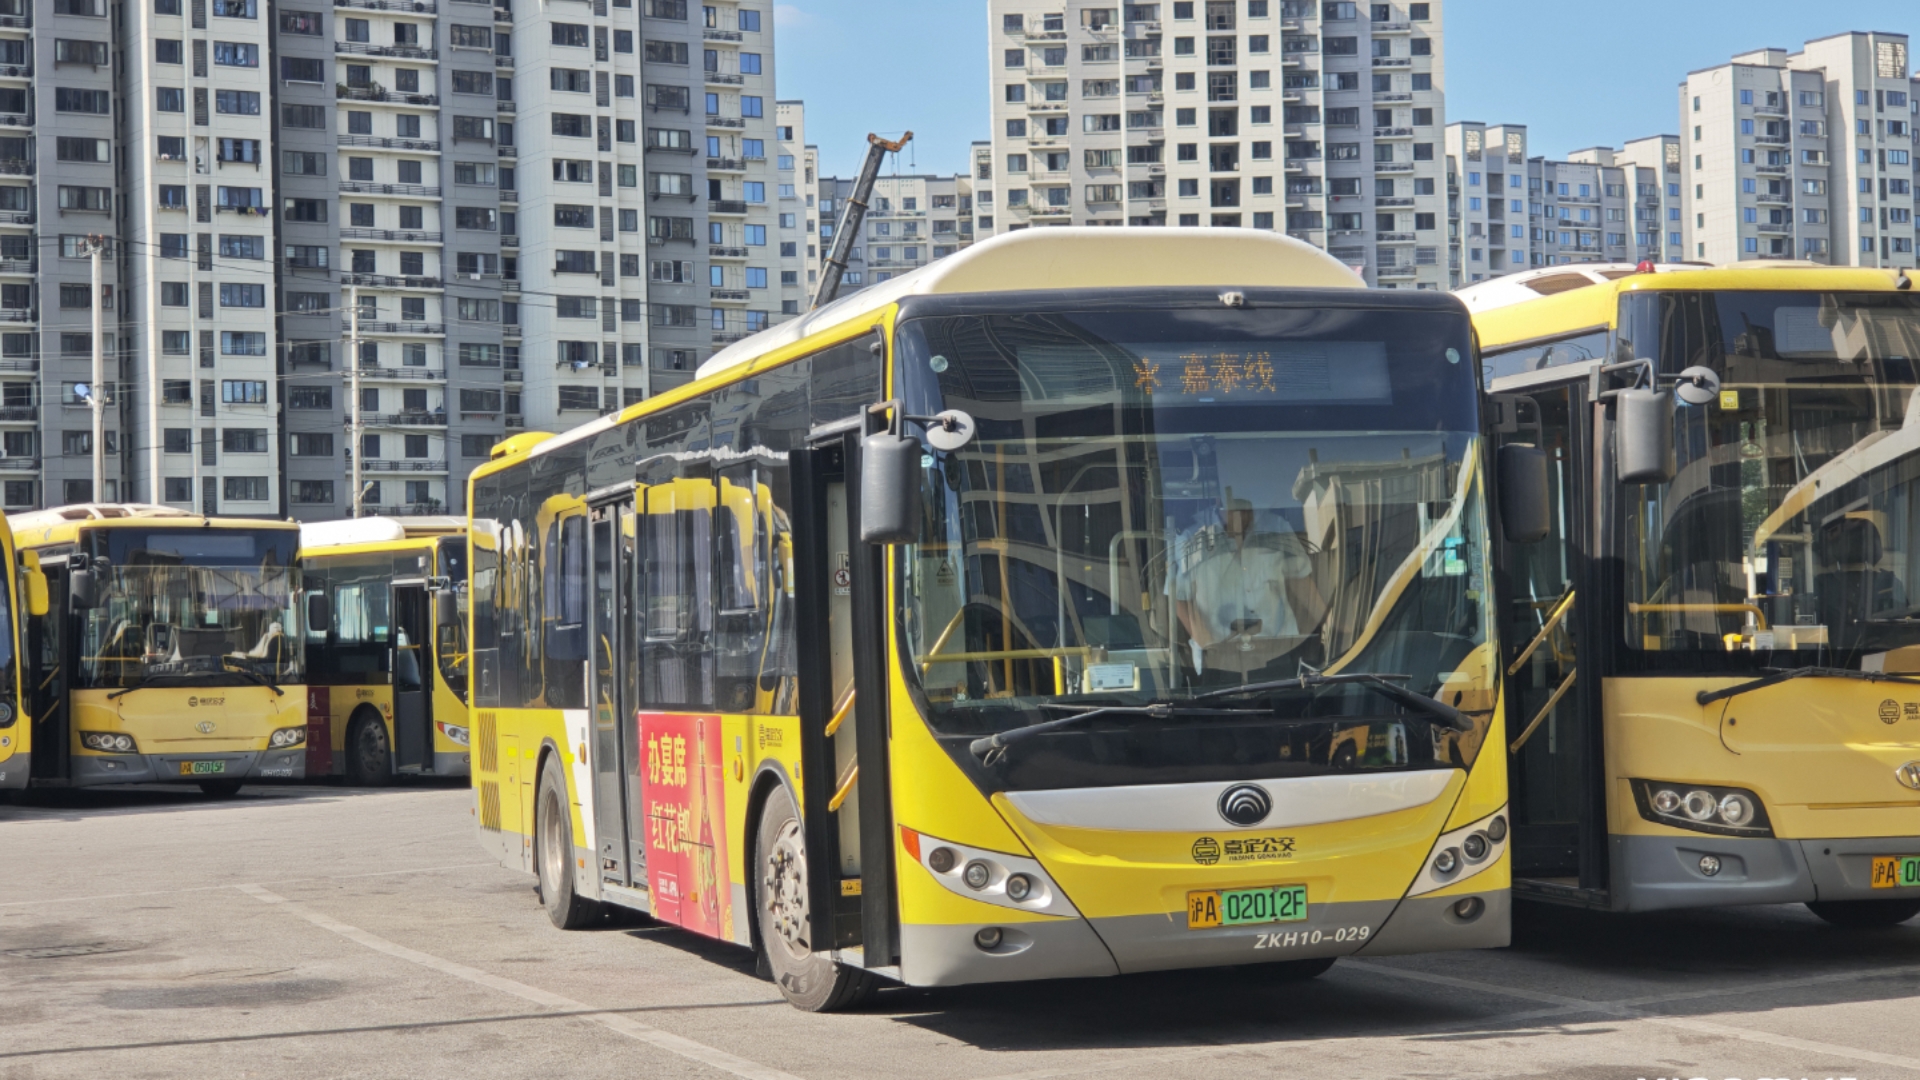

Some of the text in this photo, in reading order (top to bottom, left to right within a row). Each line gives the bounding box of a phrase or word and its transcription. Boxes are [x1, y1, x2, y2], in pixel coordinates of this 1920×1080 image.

[648, 732, 687, 788] 办宴席
[651, 801, 693, 857] 红花郎
[1224, 837, 1297, 856] 嘉定公交
[1253, 926, 1370, 949] ZKH10-029
